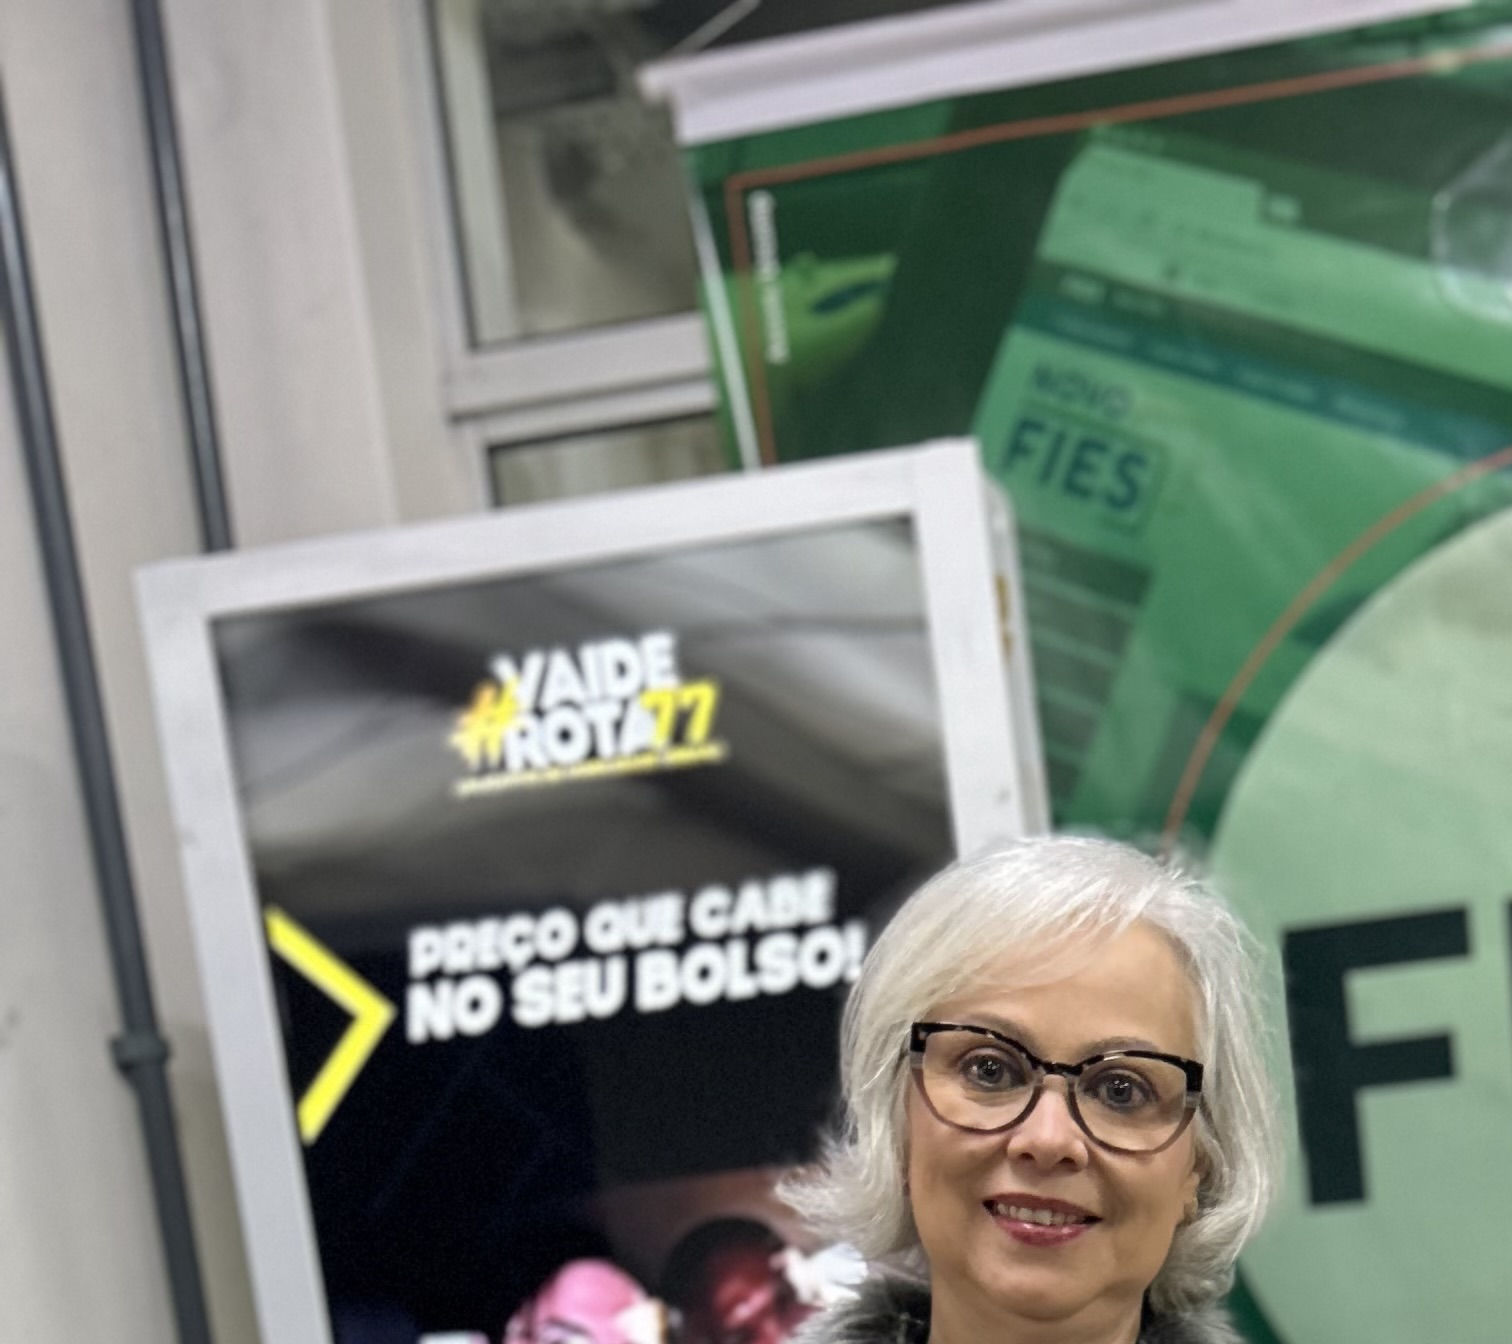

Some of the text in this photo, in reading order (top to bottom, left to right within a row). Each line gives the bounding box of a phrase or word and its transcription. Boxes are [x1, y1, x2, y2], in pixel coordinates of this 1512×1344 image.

[1001, 416, 1150, 512] FIES
[408, 866, 836, 976] PREÇO QUE CABE
[407, 921, 868, 1044] NO SEU BOLSO!
